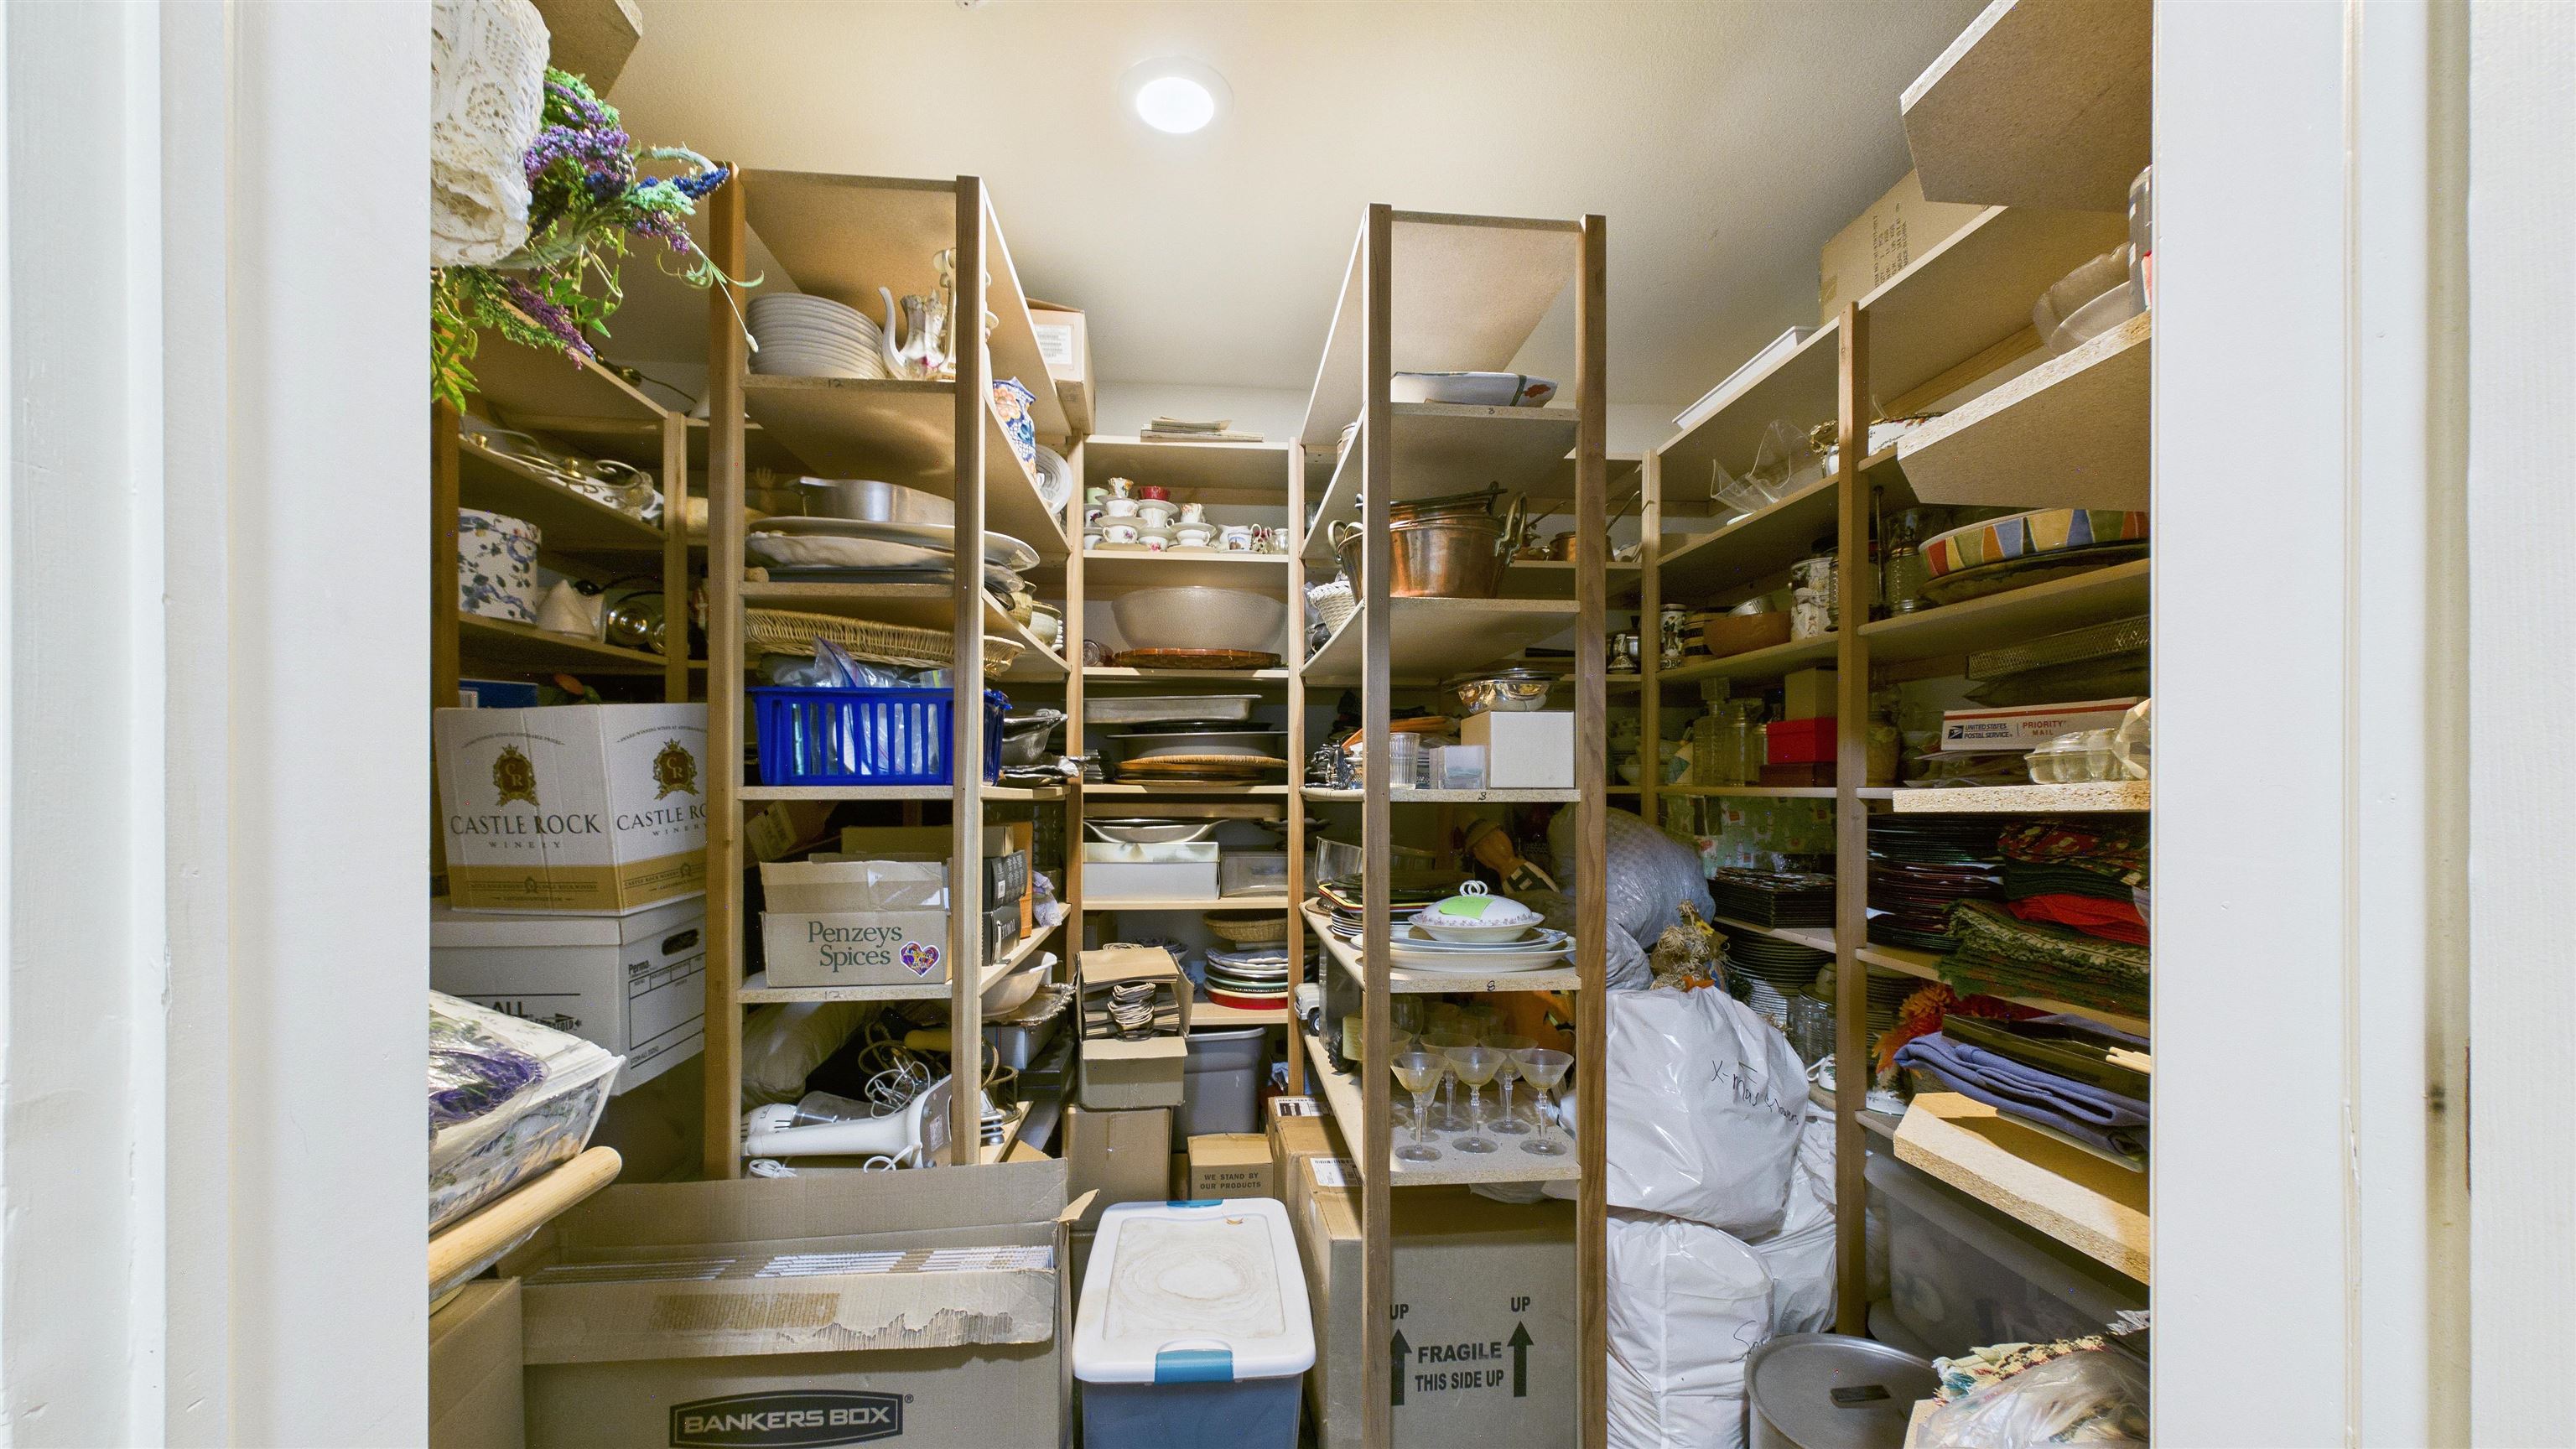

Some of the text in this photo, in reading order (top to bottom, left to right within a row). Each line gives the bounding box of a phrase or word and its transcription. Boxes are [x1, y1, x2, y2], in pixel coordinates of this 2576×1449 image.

[2023, 720, 2064, 730] PRIORITY
[450, 814, 601, 835] CASTLE ROCK
[616, 802, 707, 831] CASTLE RO
[808, 921, 903, 948] Penzeys
[819, 945, 891, 973] Spices
[1220, 1181, 1261, 1189] PRODUCTS
[1389, 1304, 1409, 1320] UP
[1511, 1296, 1531, 1312] UP
[1418, 1342, 1502, 1363] FRAGILE
[1415, 1369, 1504, 1392] THIS SIDE UP
[684, 1405, 892, 1435] BANKERS BOX
